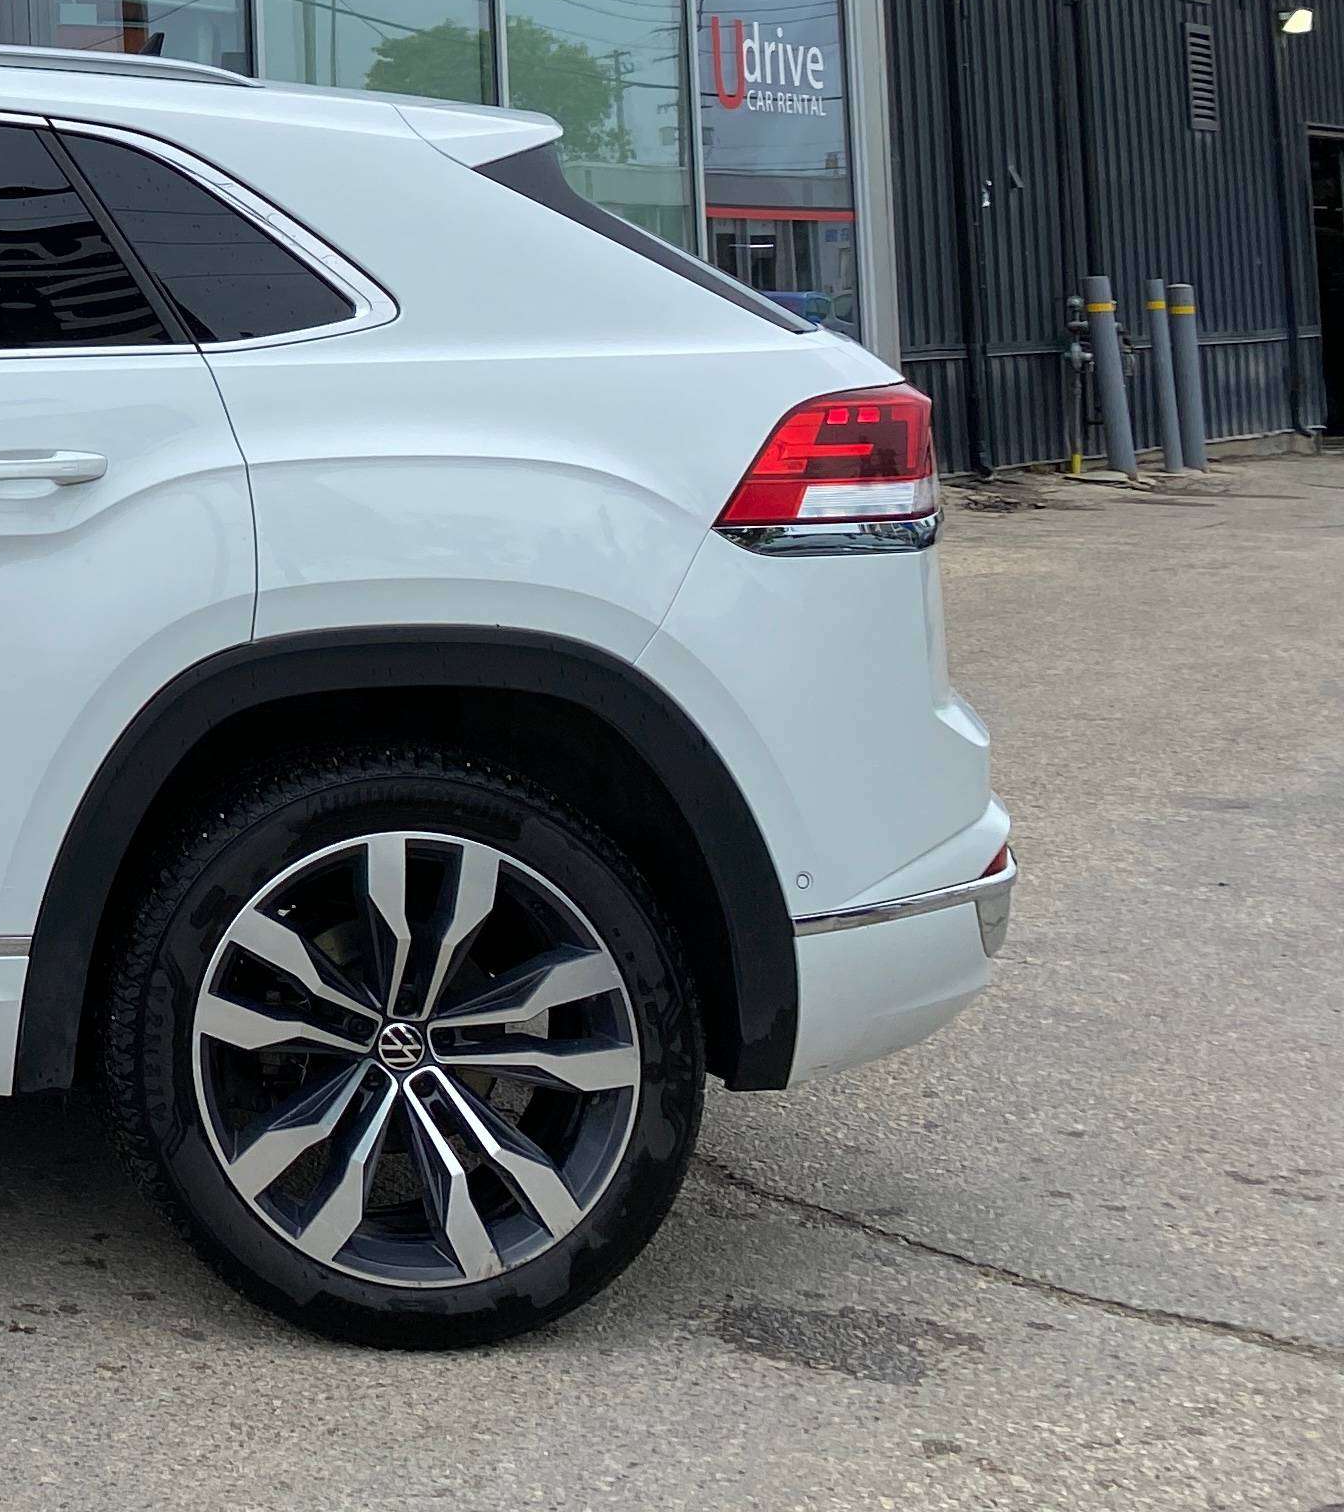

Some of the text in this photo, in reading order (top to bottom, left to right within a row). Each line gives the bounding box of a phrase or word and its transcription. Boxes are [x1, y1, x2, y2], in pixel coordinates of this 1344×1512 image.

[711, 16, 825, 110] Udrive
[746, 89, 827, 116] CAR RENTAL
